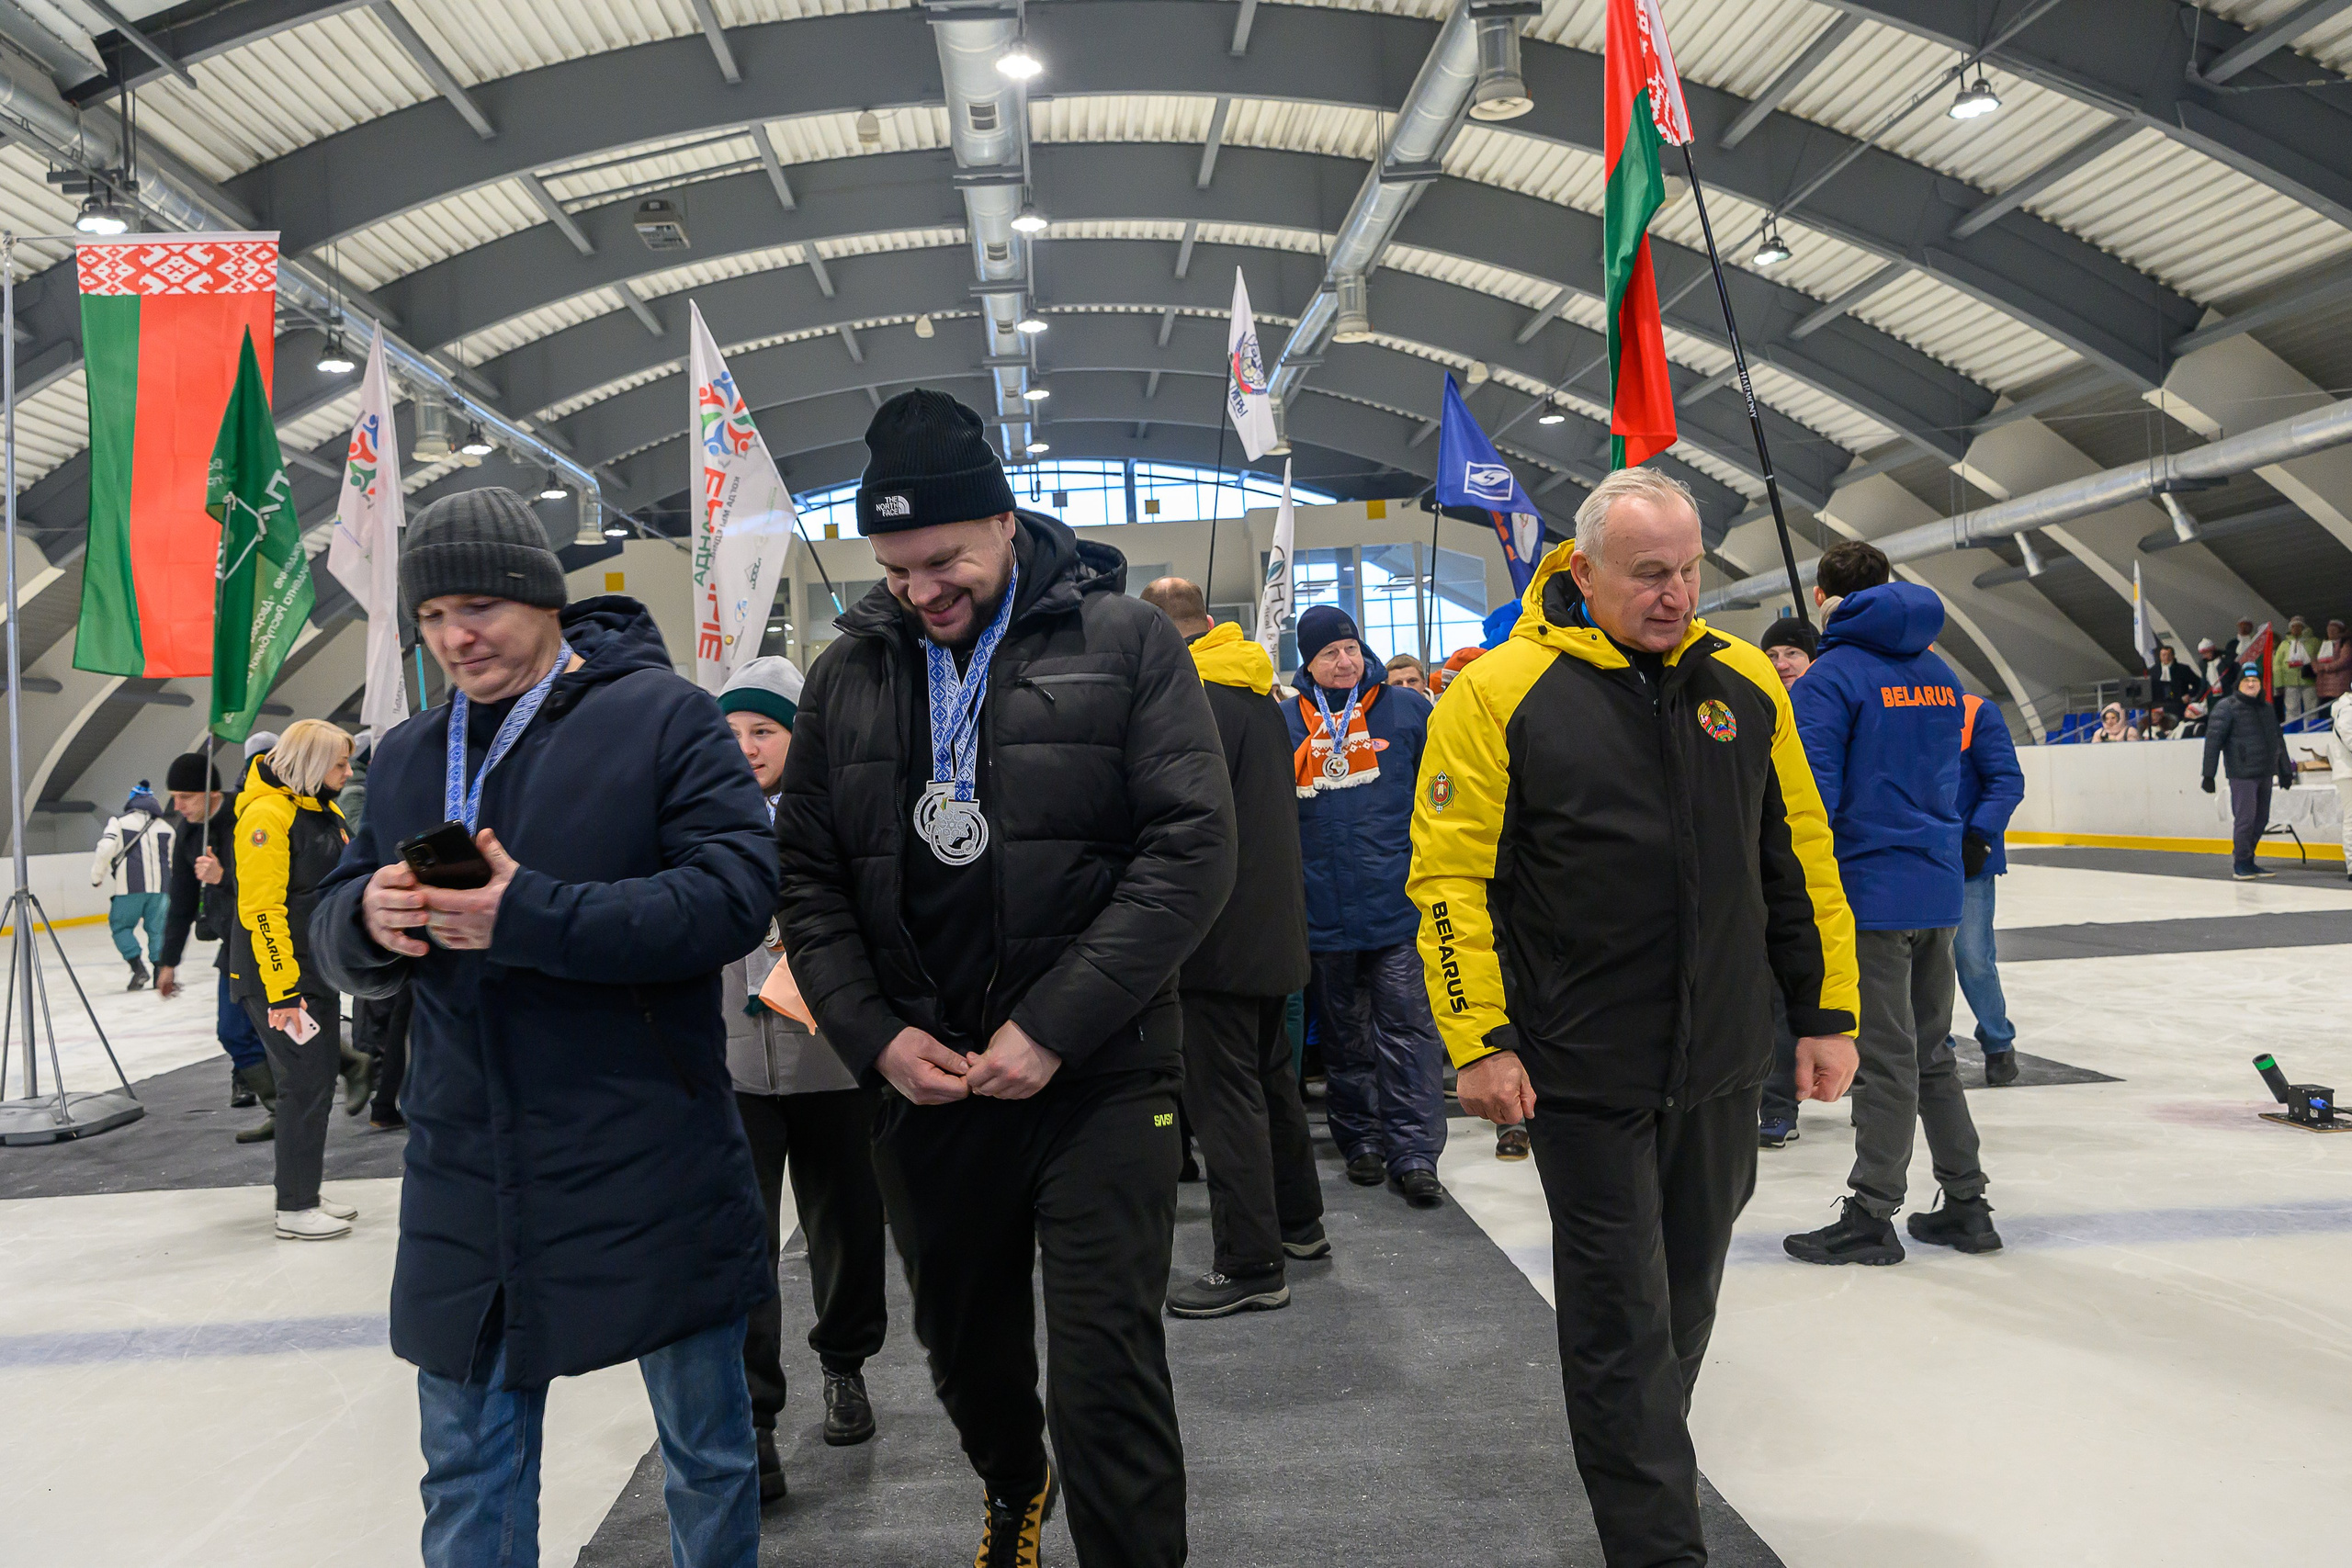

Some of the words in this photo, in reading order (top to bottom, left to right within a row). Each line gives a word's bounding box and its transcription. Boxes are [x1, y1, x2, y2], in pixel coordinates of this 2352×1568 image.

[1739, 371, 1758, 418] HARMONY
[876, 502, 899, 513] NORTH
[882, 508, 899, 517] FACE
[1880, 685, 1957, 707] BELARUS
[257, 913, 284, 973] BELARUS
[1432, 901, 1470, 1014] BELARUS
